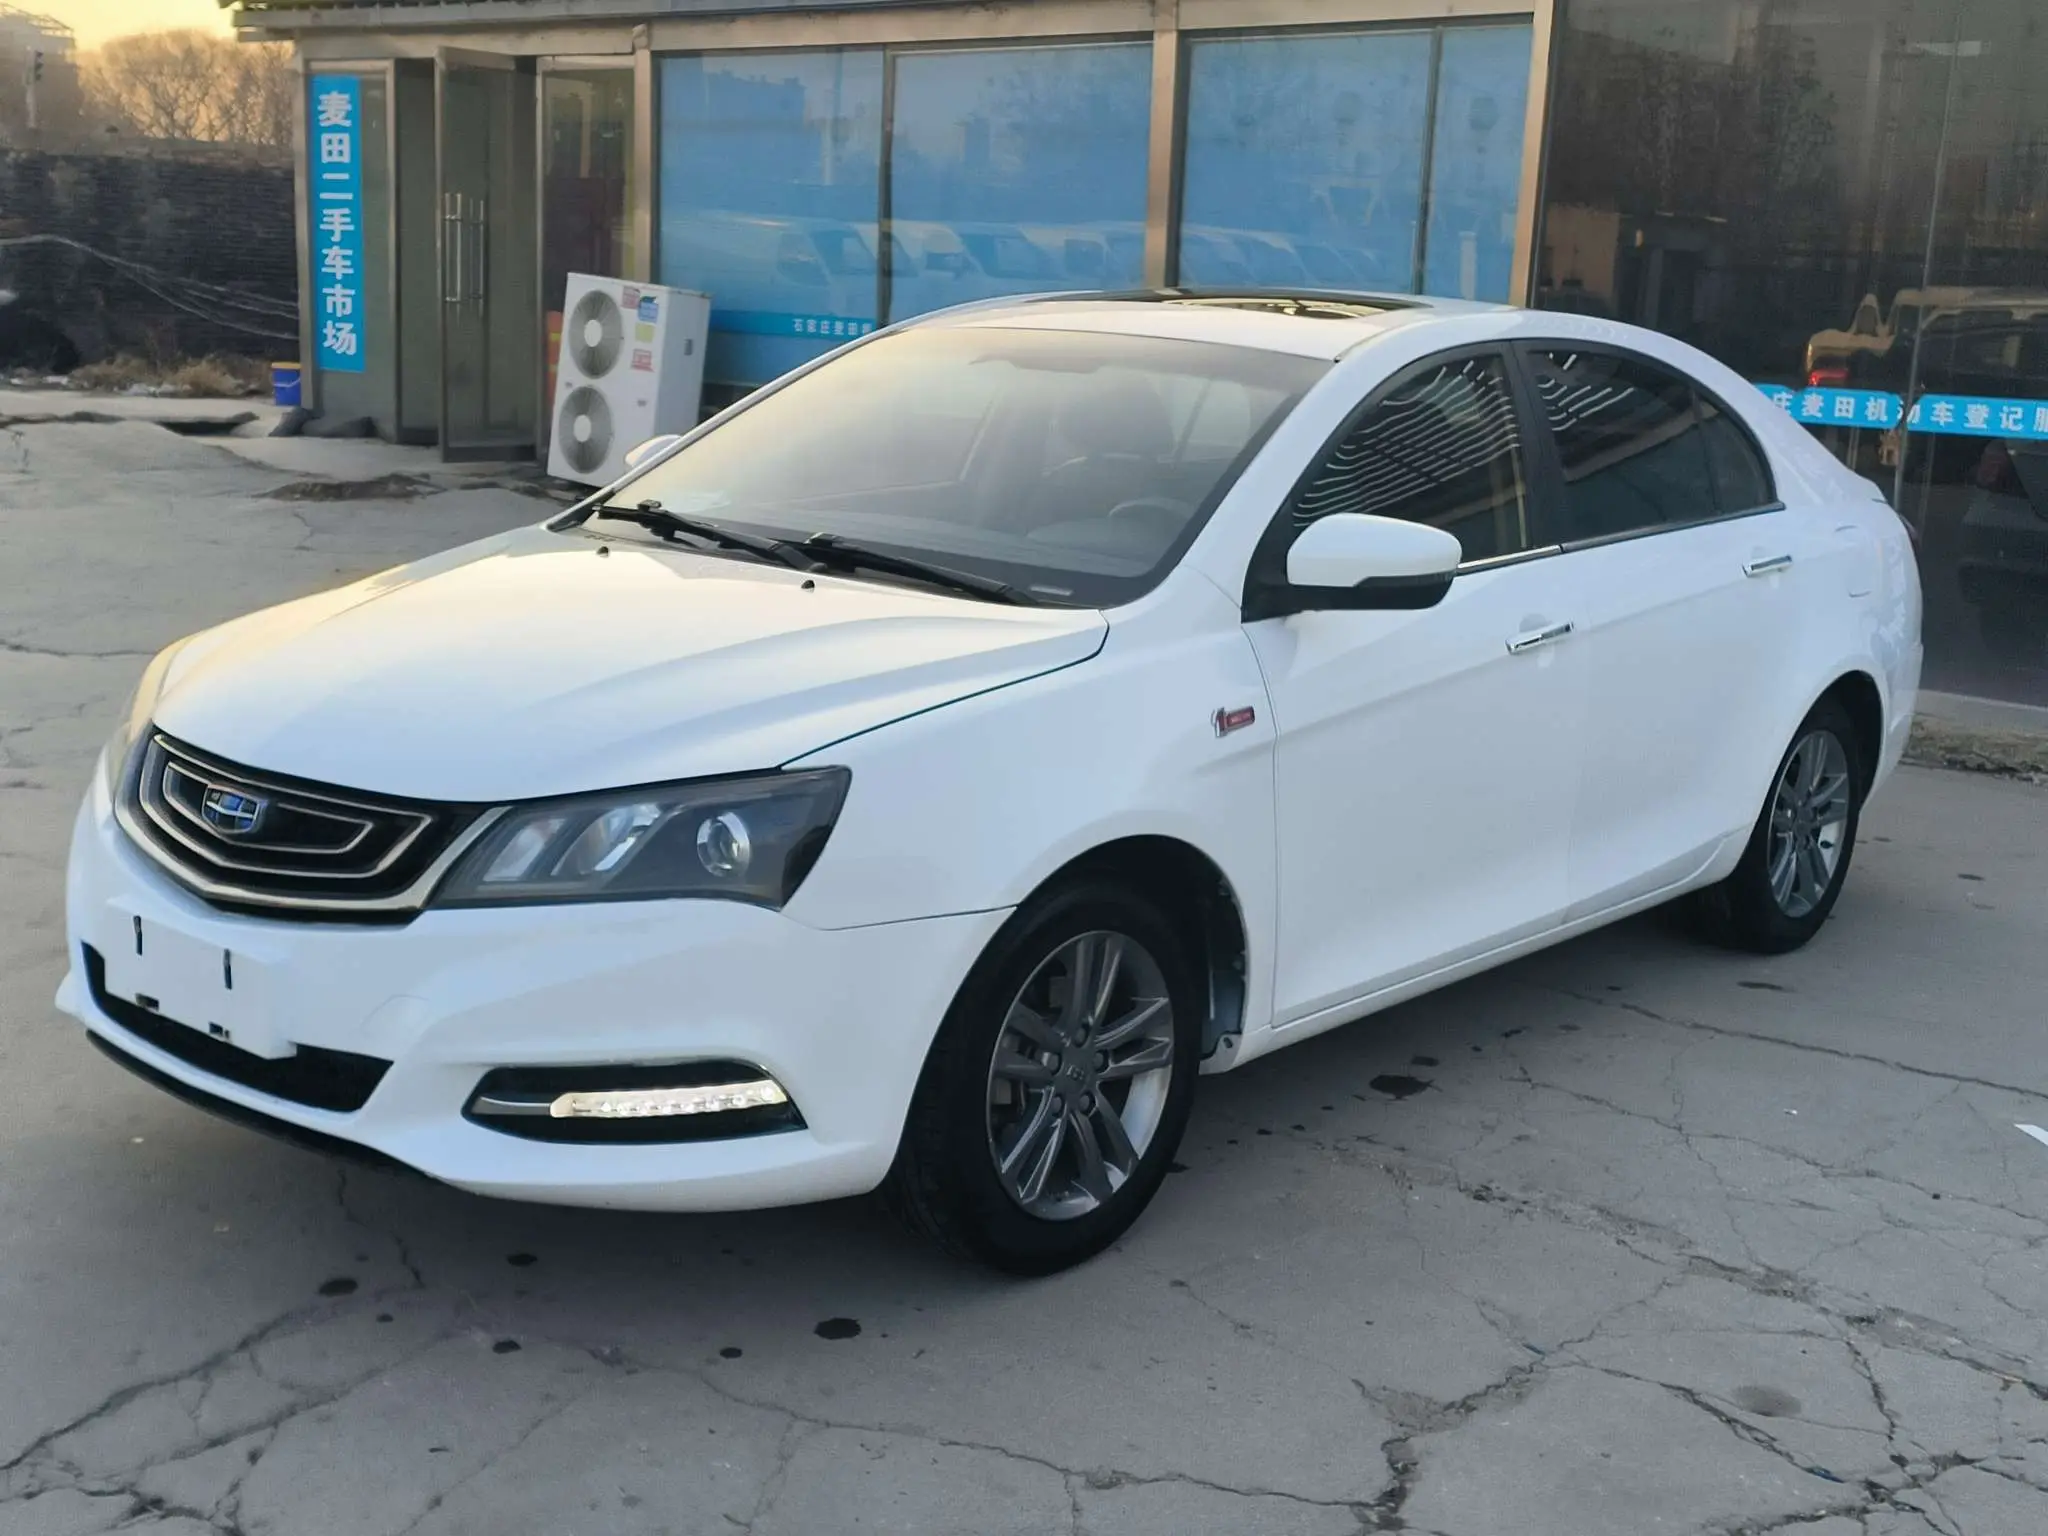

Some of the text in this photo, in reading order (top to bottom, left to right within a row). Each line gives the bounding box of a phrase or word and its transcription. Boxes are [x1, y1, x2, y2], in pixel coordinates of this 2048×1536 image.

[317, 90, 357, 356] 麦田二手车市场
